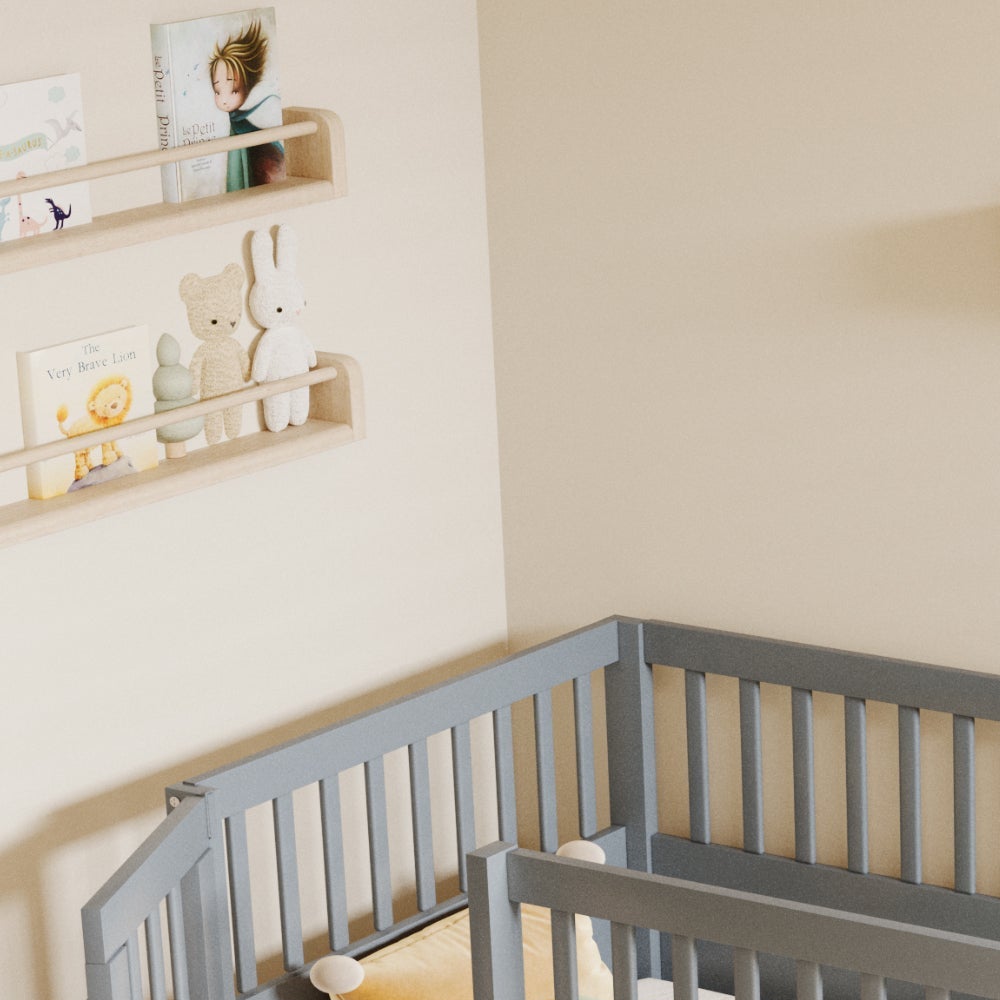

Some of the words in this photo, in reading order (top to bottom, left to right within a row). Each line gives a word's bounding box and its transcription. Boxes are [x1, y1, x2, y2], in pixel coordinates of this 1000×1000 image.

[153, 70, 166, 103] Petit
[157, 115, 171, 151] Princ
[191, 121, 216, 136] Petit
[81, 343, 101, 355] The
[47, 366, 73, 381] Very
[78, 358, 108, 373] Brave
[112, 351, 137, 364] Lion
